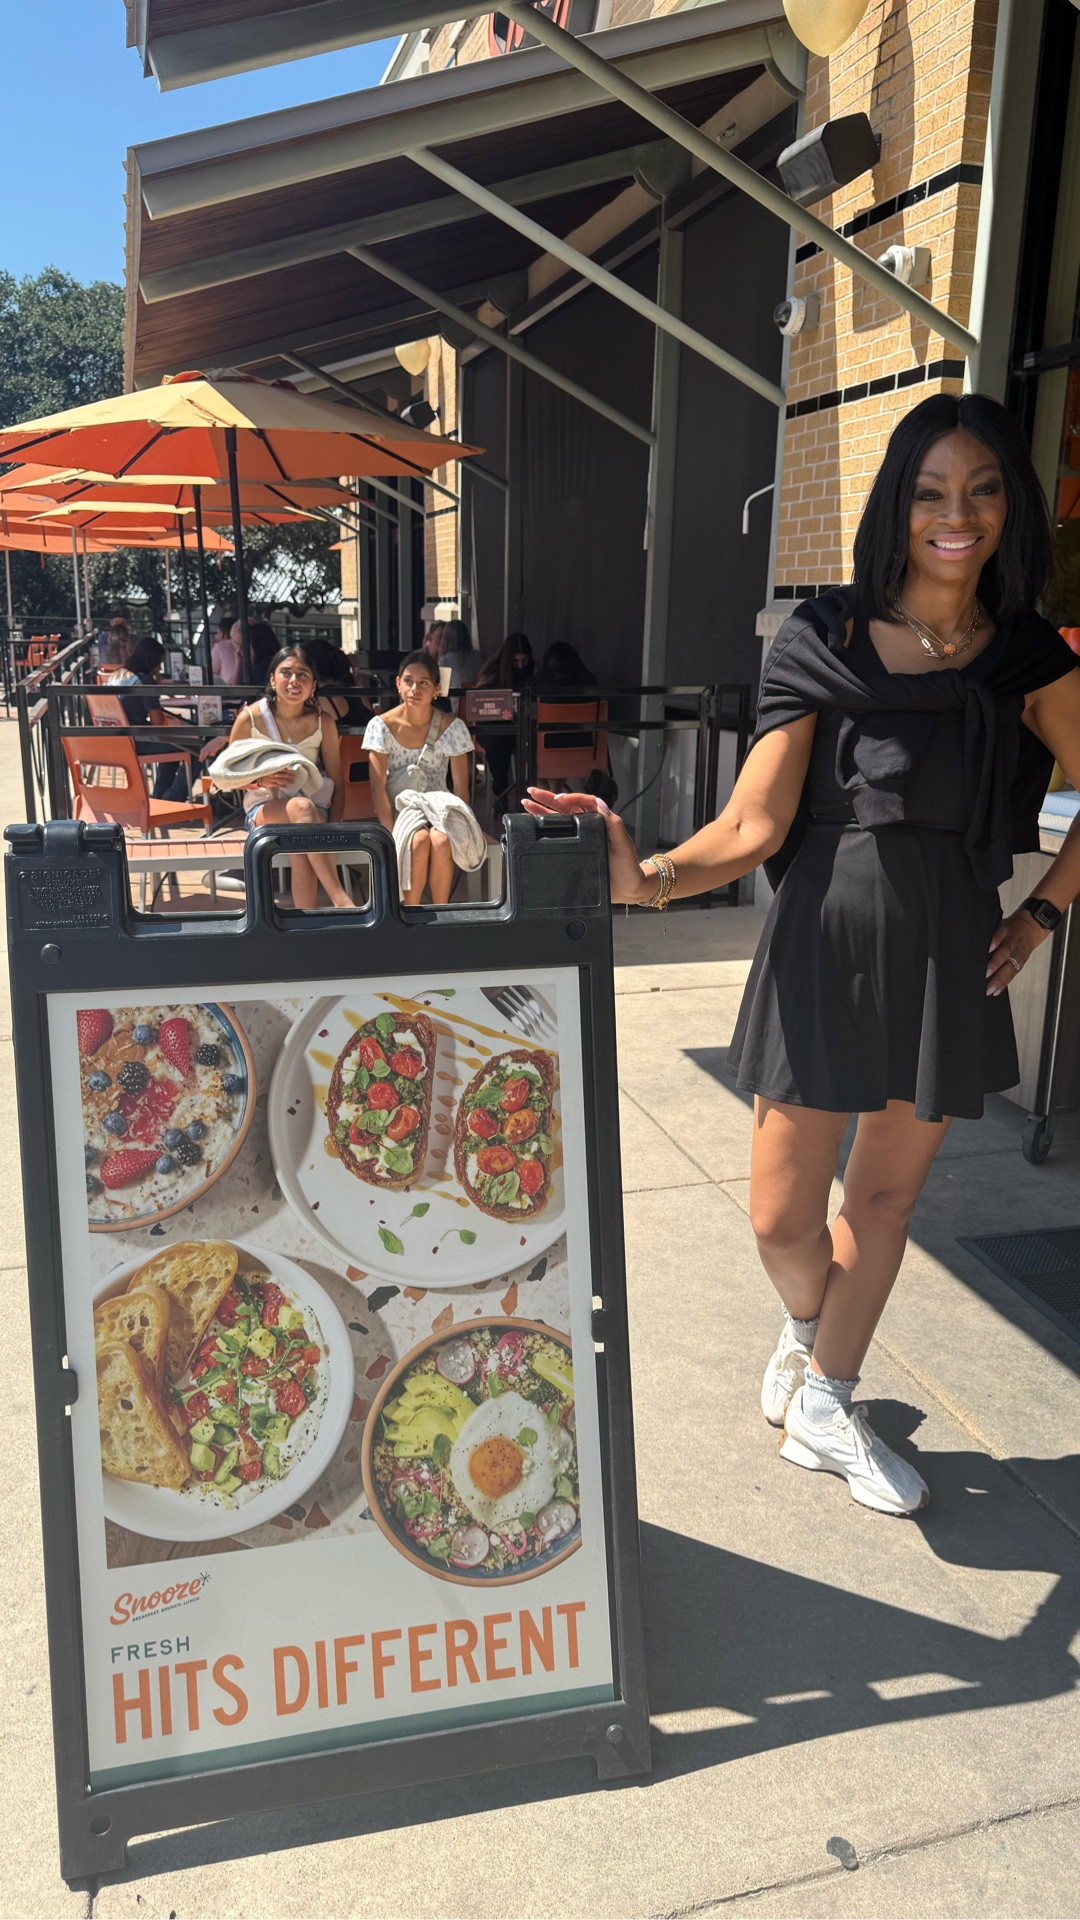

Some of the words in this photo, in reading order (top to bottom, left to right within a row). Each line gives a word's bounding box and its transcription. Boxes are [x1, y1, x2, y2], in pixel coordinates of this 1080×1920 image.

[109, 1578, 202, 1626] Snooze
[111, 1636, 190, 1664] FRESH
[112, 1653, 249, 1744] HITS
[273, 1601, 587, 1716] DIFFERENT
